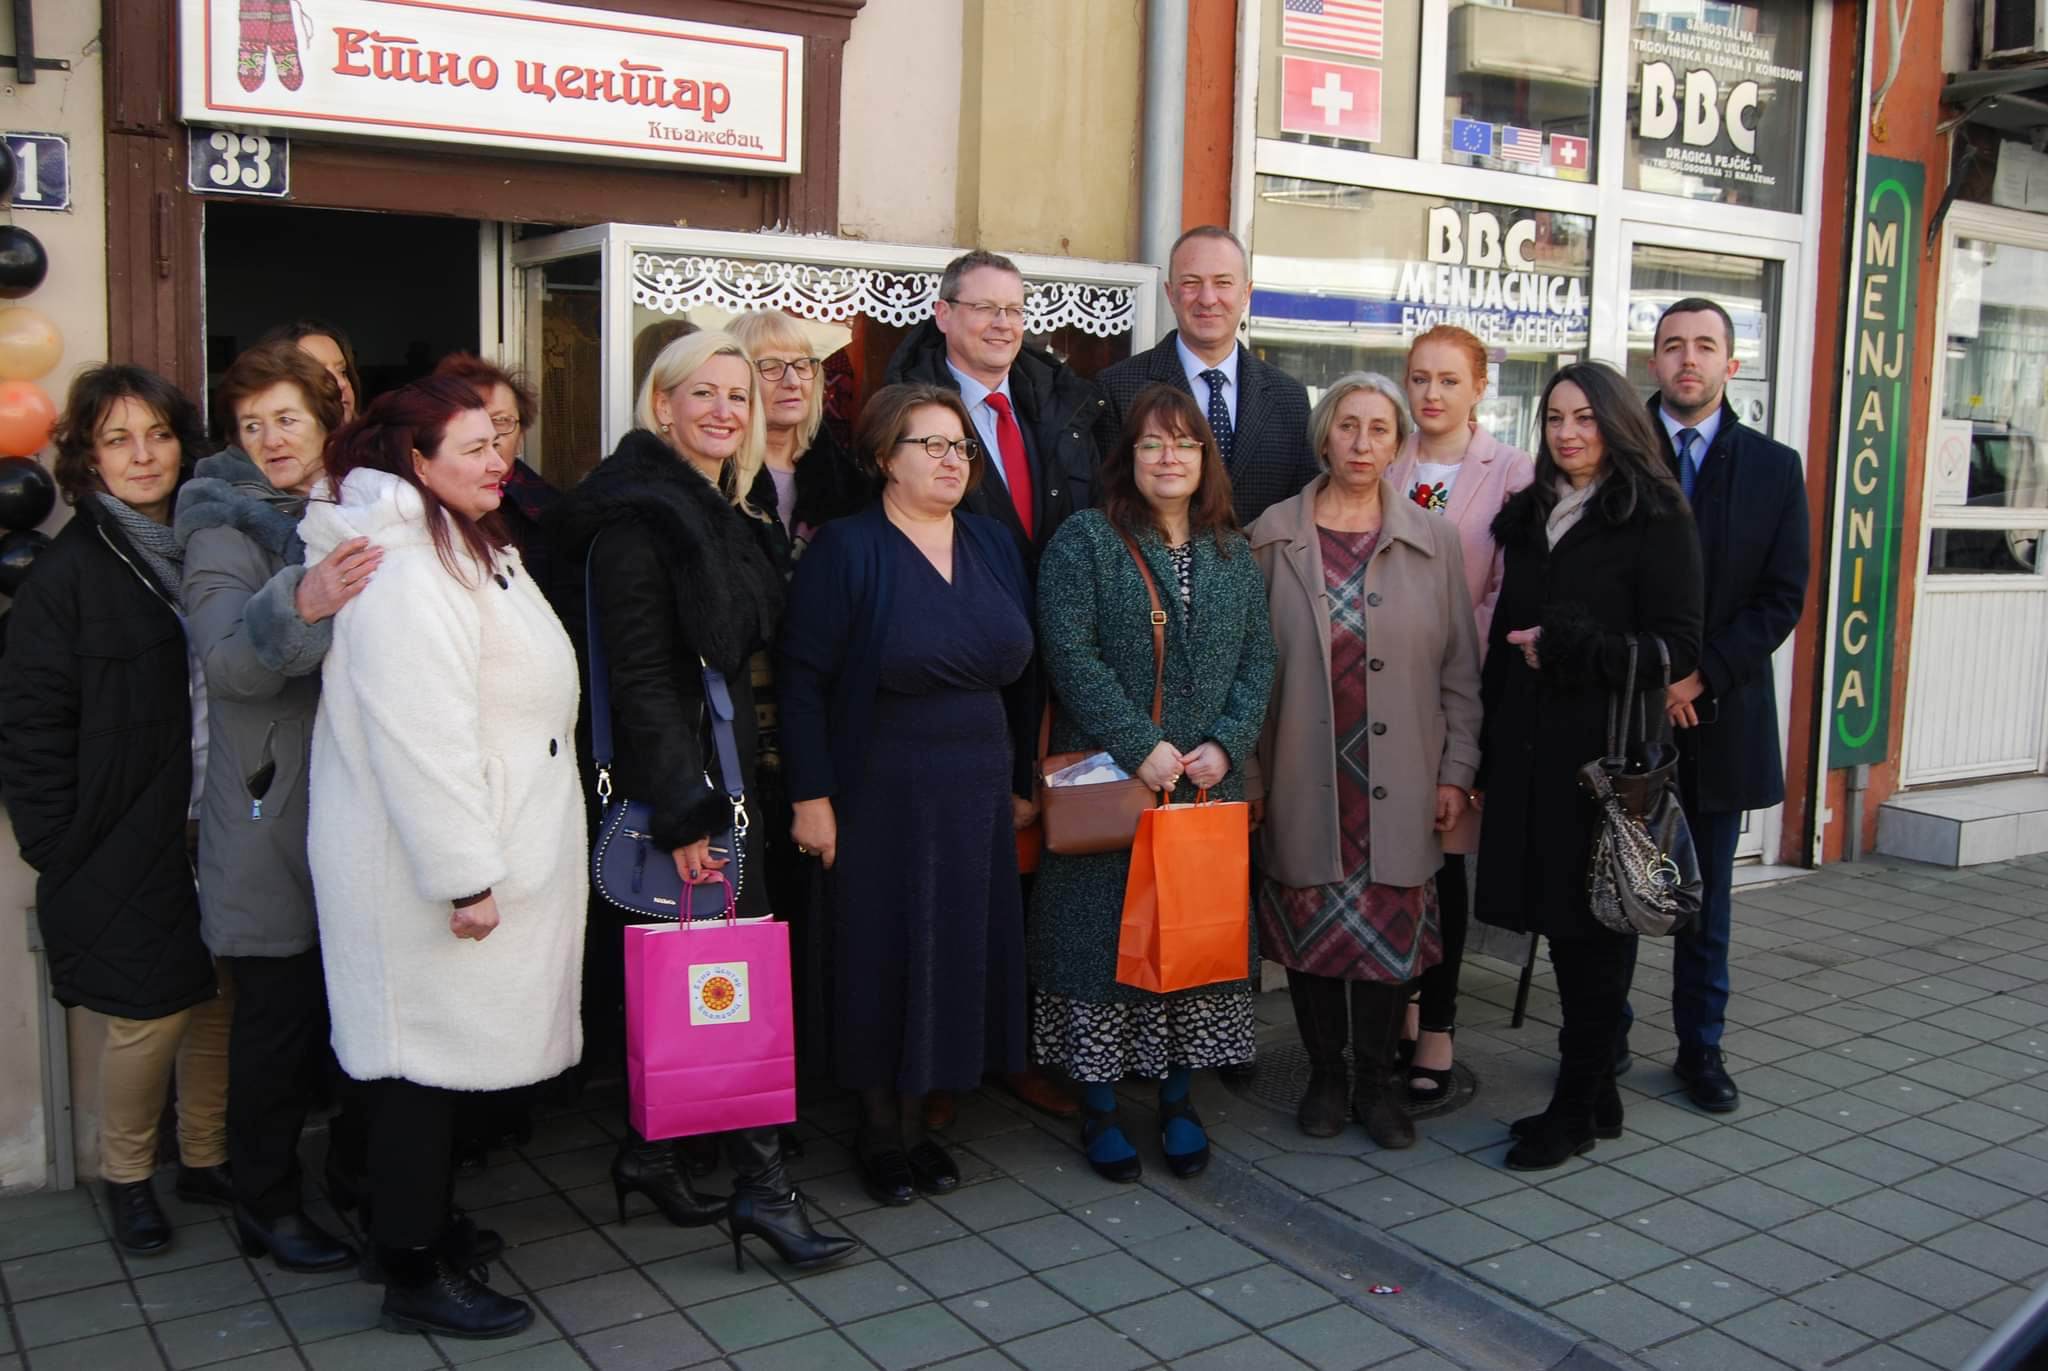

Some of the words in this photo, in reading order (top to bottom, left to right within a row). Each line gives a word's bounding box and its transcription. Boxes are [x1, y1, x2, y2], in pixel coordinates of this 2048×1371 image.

[1667, 31, 1721, 51] ZANATSKO
[1686, 19, 1754, 43] SAMOSTALNA
[1632, 38, 1701, 63] TRGOVINSKA
[1704, 52, 1745, 73] RADNJA
[1748, 61, 1752, 73] I
[1755, 63, 1804, 83] KOMISION
[1639, 60, 1759, 155] BBC
[647, 120, 764, 151] Књажевац
[209, 130, 272, 189] 33
[1665, 147, 1713, 166] DRAGICA
[1714, 154, 1751, 171] PEJČIĆ
[1427, 206, 1537, 273] BBC
[1512, 317, 1572, 348] OFFICE
[1837, 219, 1905, 710] MENJAČNICA
